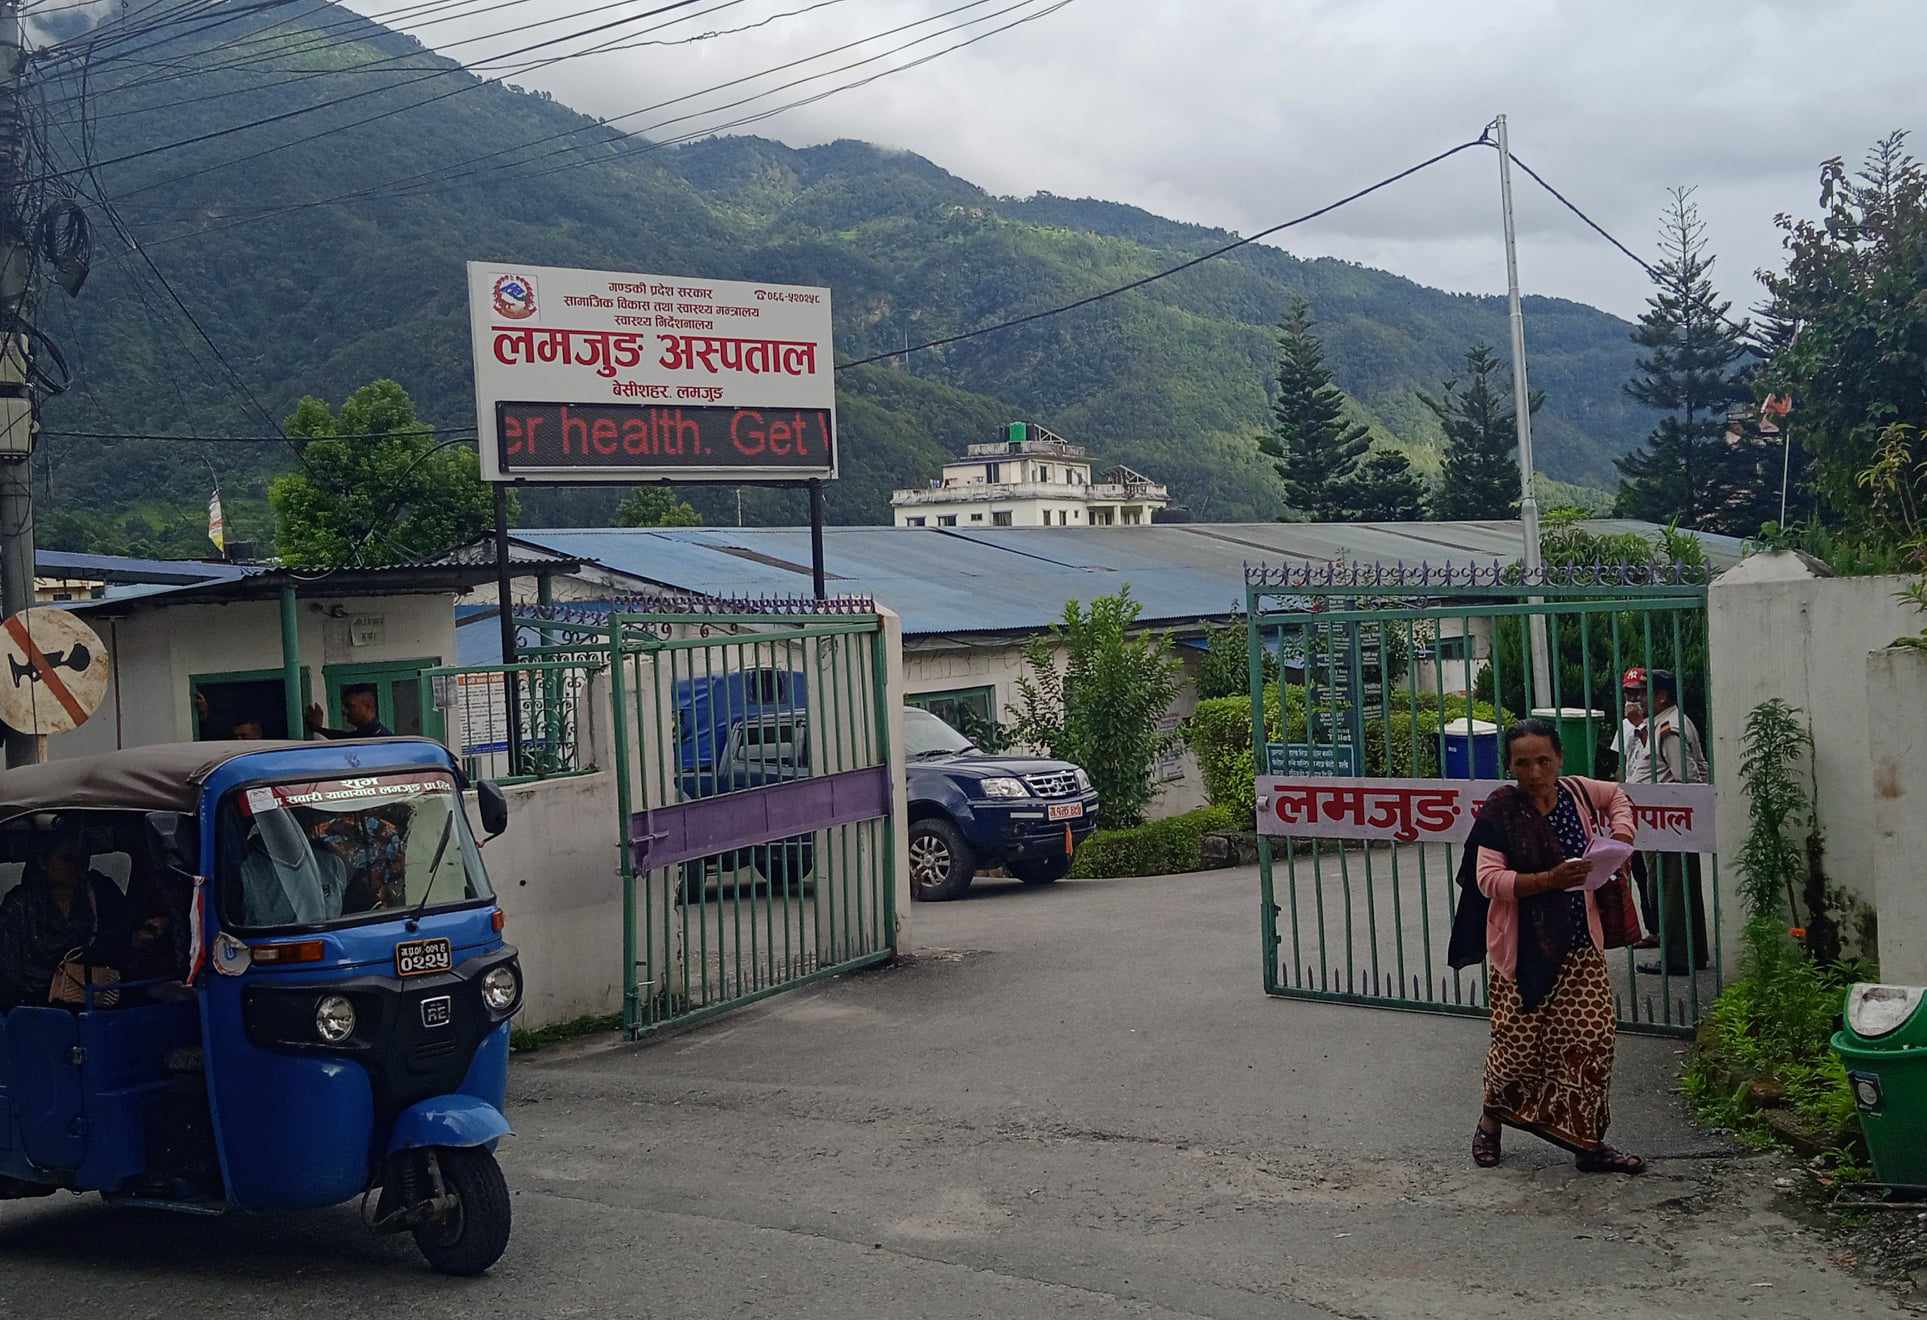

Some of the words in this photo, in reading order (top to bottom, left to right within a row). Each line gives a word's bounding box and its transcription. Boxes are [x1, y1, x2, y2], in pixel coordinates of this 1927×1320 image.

[608, 282, 646, 295] गण्डकी
[650, 283, 674, 297] प्रदेश
[677, 287, 713, 299] सरकार
[564, 294, 613, 308] सामाजिक
[617, 296, 650, 310] विकास
[654, 301, 673, 313] तथा
[676, 302, 713, 315] स्वास्थ्य
[614, 315, 651, 327] स्वास्थ्य
[655, 315, 713, 330] निर्देशनालय
[491, 326, 645, 378] लमजुङ
[656, 333, 817, 376] अस्पताल
[676, 385, 724, 402] लमजुङ
[560, 406, 712, 456] health.
[730, 409, 808, 456] Get
[326, 786, 376, 801] यातायात
[1273, 784, 1461, 842] लमजुङ
[401, 952, 449, 971] ०२२५
[428, 1006, 446, 1021] RE
